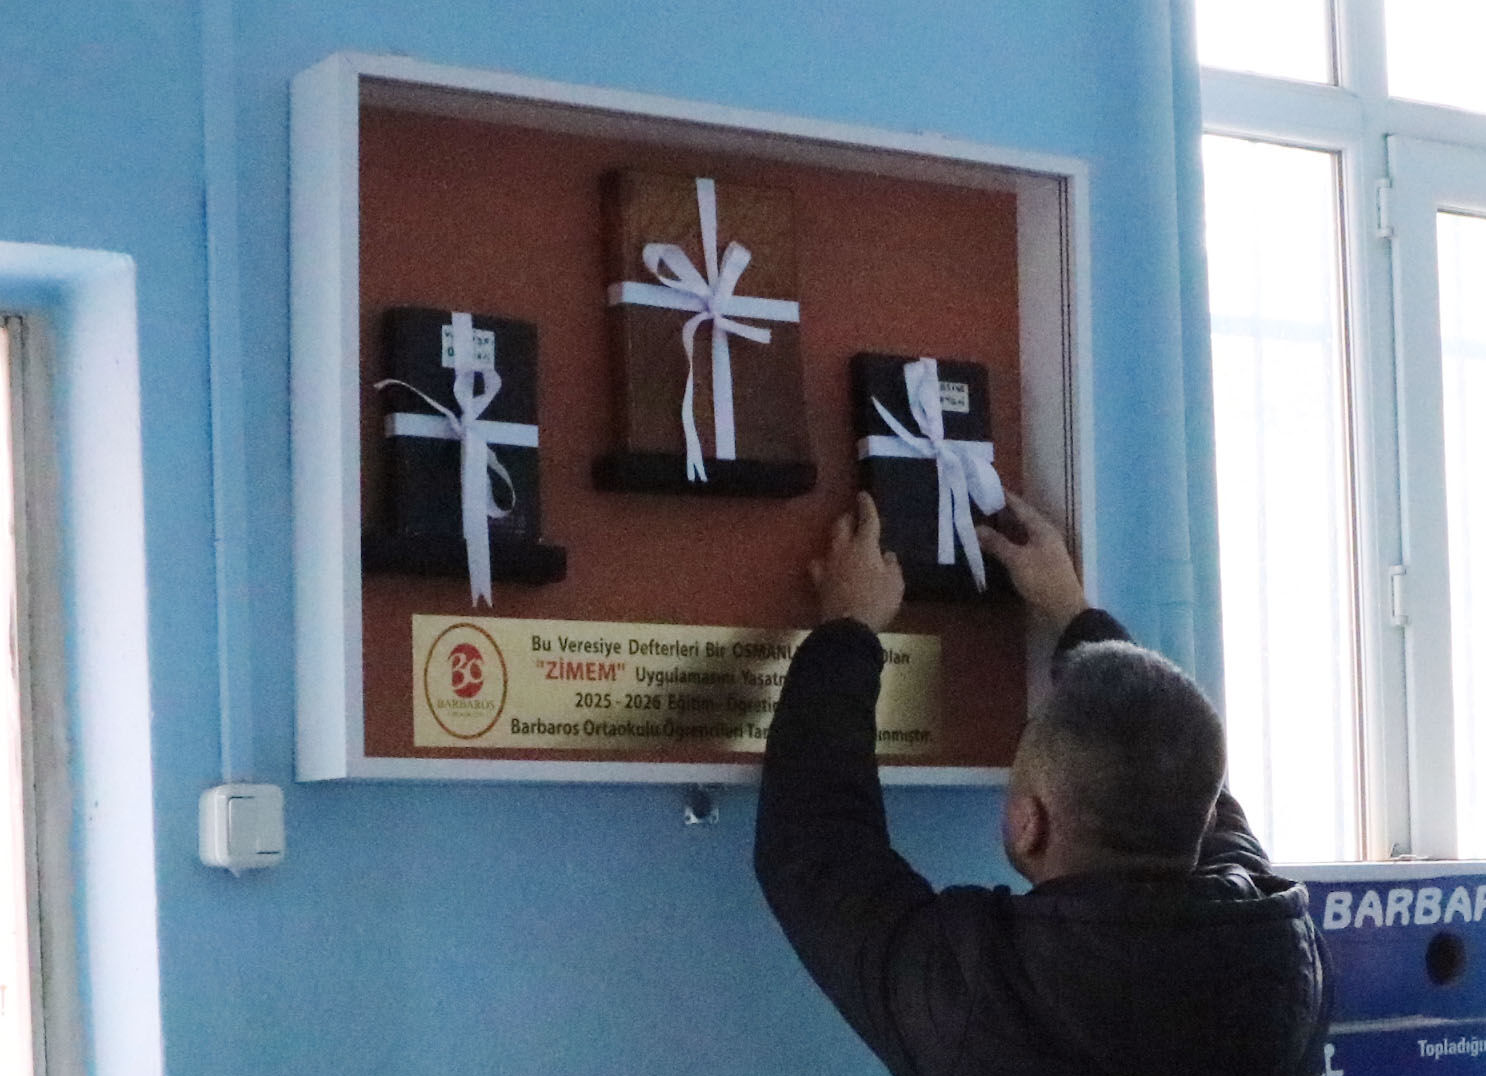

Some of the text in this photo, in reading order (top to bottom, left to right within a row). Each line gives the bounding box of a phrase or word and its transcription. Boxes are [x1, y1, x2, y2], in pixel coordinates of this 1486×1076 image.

[531, 635, 551, 651] Bu
[558, 635, 622, 657] Veresiye
[628, 638, 699, 657] Defterleri
[705, 641, 726, 658] Bir
[732, 641, 795, 661] OSMANL
[536, 657, 625, 681] "ZİMEM"
[575, 692, 612, 708] 2025
[625, 693, 661, 710] 2026
[511, 718, 580, 736] Barbaros
[583, 719, 660, 738] Ortaokulu
